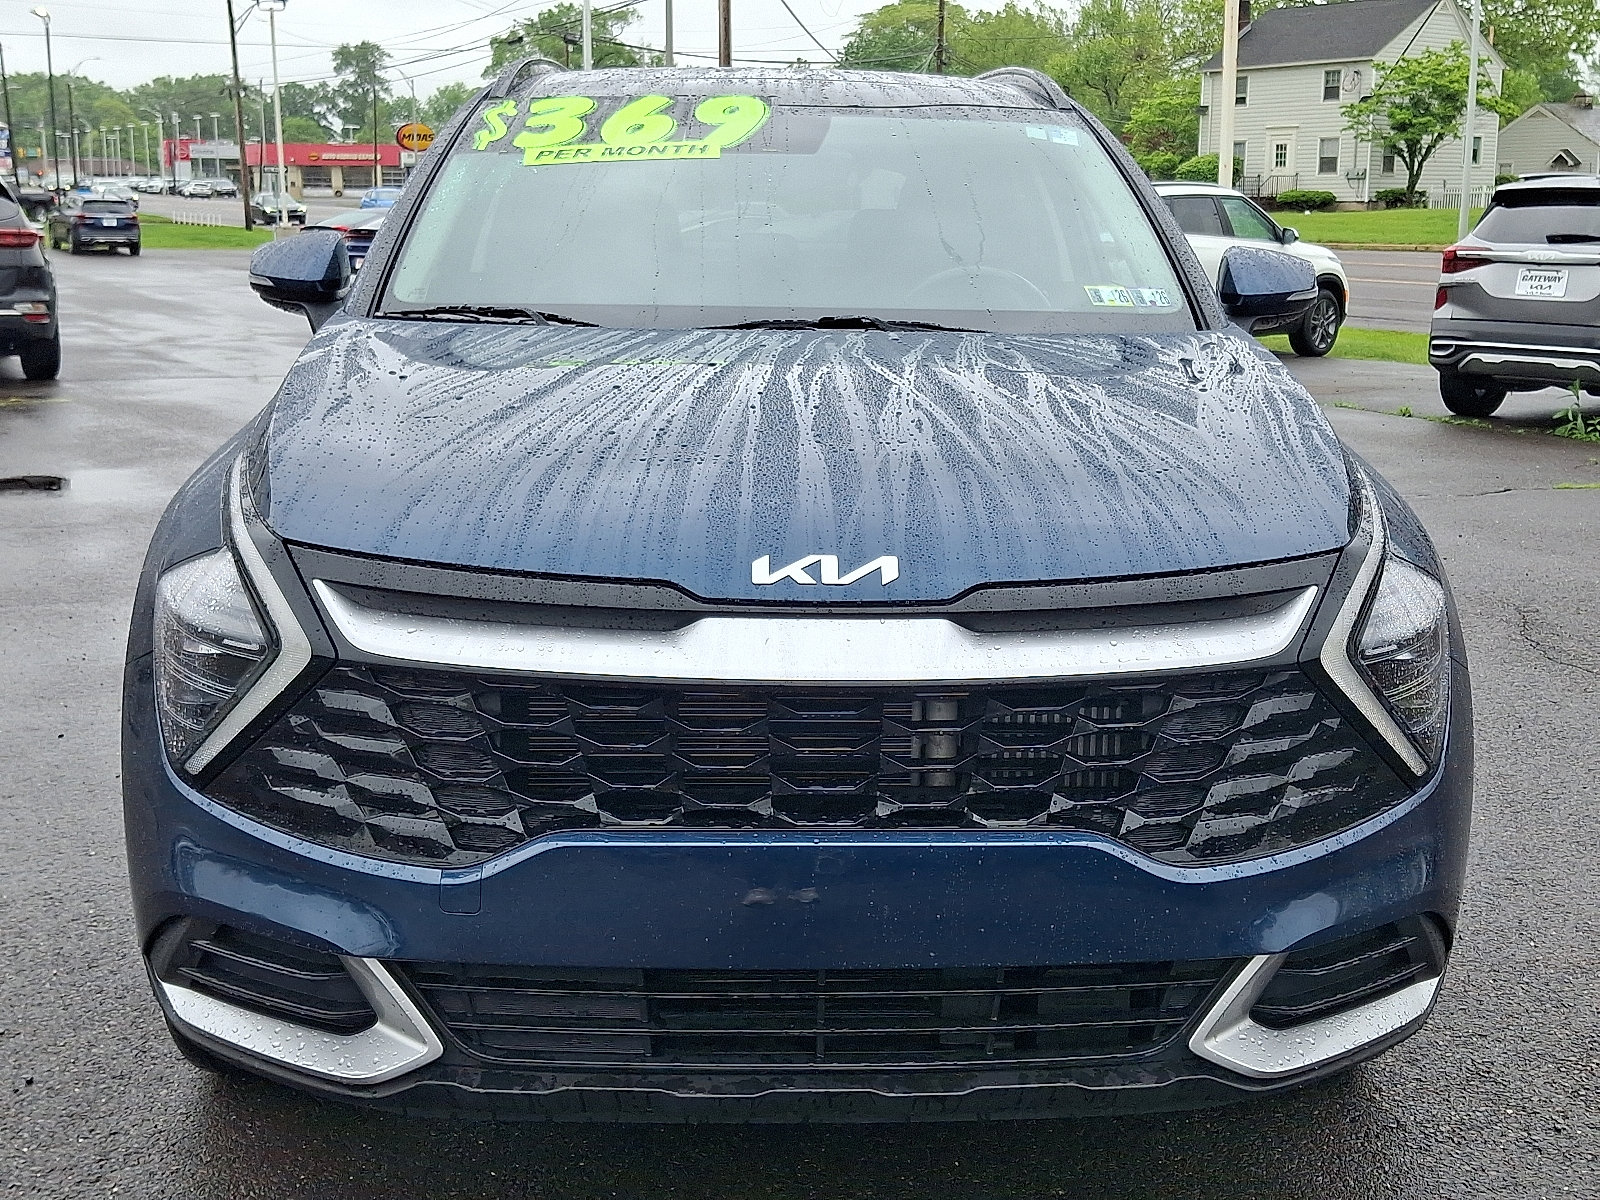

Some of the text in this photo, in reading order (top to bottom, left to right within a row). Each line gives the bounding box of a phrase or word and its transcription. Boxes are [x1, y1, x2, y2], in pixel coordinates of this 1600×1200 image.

[472, 95, 770, 150] $369
[402, 133, 434, 142] MIDAS
[535, 144, 710, 161] PER MONTH
[1521, 274, 1564, 284] GATEWAY
[751, 554, 899, 586] KIA
